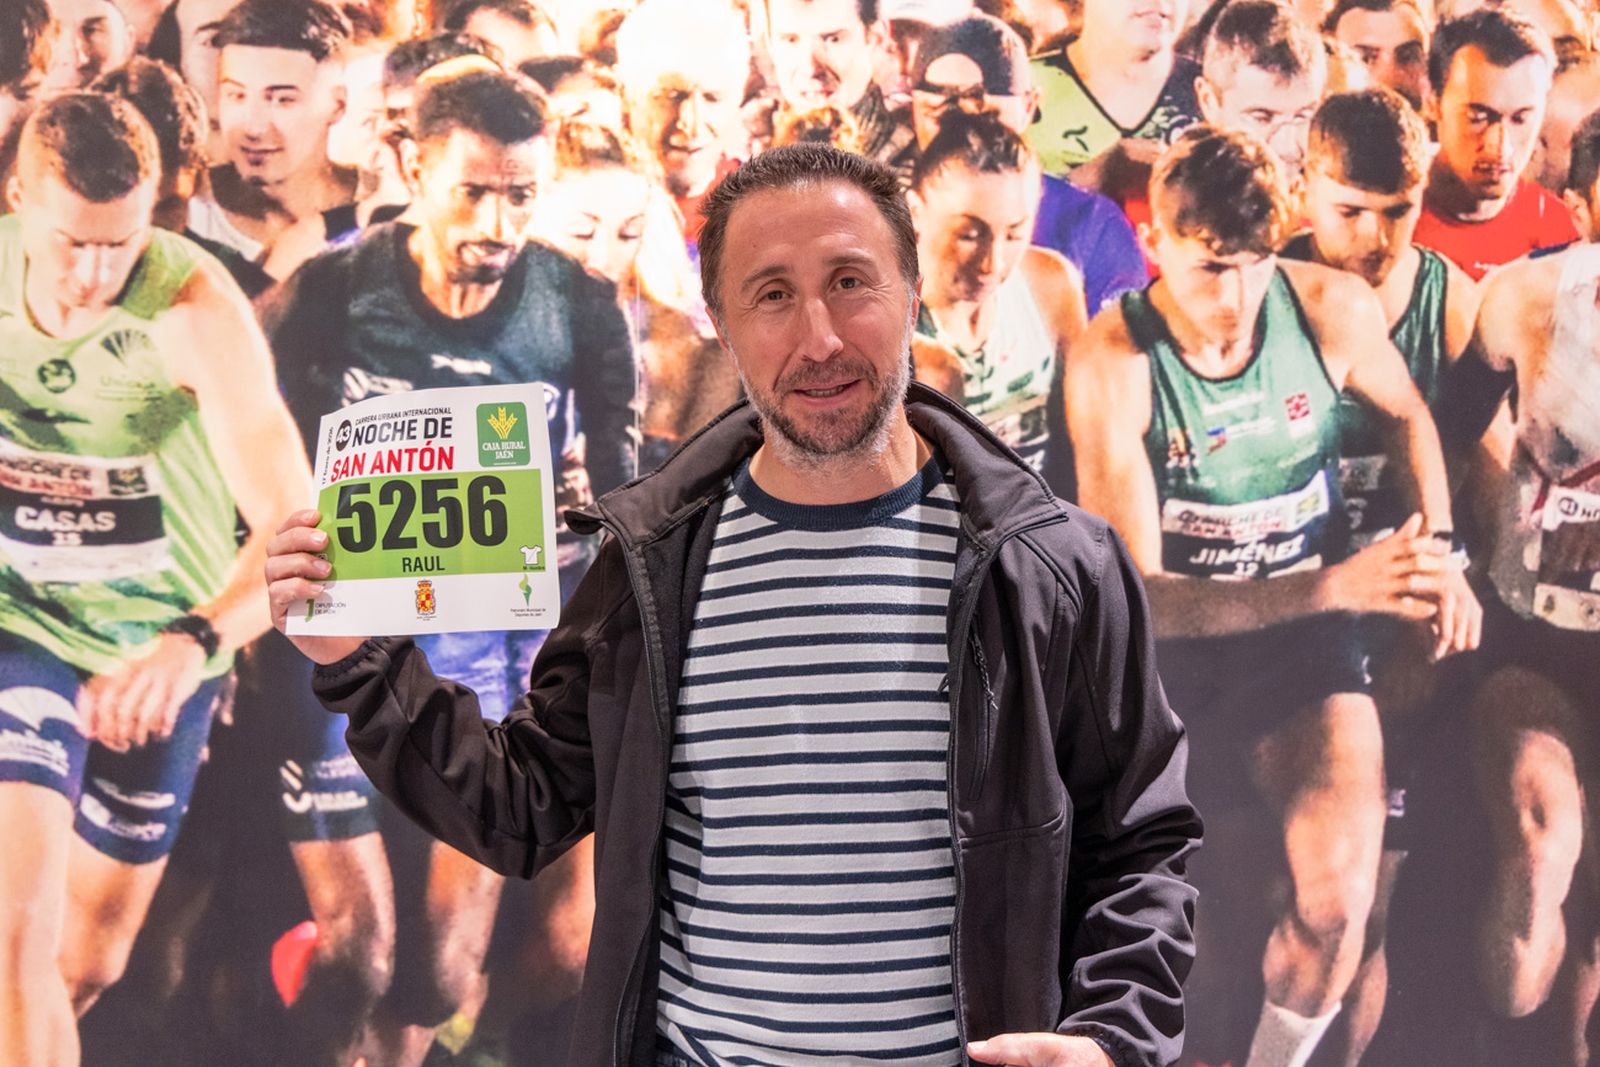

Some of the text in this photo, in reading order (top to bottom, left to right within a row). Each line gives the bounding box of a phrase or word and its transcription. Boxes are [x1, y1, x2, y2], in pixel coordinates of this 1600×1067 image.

[355, 407, 452, 426] CARRERA URBANA INTERNACIONAL
[352, 418, 418, 448] NOCHE
[423, 416, 453, 440] DE
[482, 440, 526, 451] CAJA RURAL
[495, 450, 514, 460] JAÉN
[330, 440, 455, 483] SAN ANTÓN
[15, 506, 117, 532] CASAS
[335, 474, 509, 553] 5256
[1189, 533, 1306, 567] JIMÉNEZ
[402, 555, 446, 573] RAUL
[315, 601, 347, 610] DIPUTACIÓN
